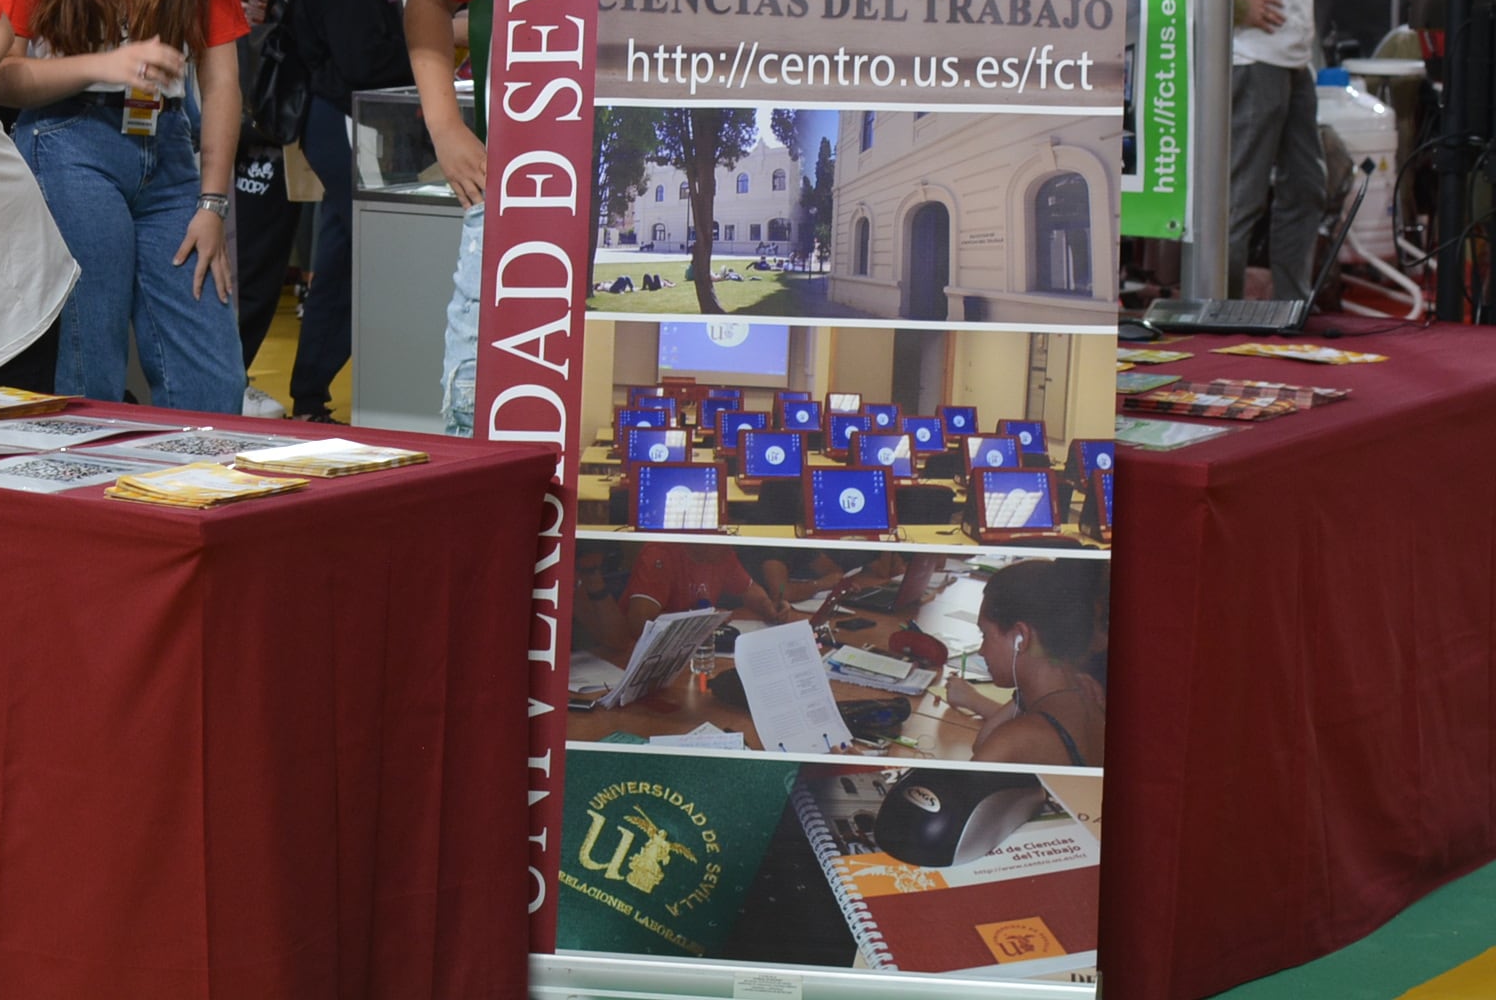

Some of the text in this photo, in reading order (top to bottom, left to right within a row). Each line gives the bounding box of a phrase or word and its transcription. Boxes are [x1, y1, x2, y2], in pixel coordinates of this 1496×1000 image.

[626, 38, 1094, 95] http://centro.us.es/fct
[589, 781, 721, 918] UNIVERSIDAD DE SEVILLA
[1012, 852, 1033, 862] del
[1034, 844, 1082, 858] Trabajo
[1023, 836, 1075, 850] Ciencias
[558, 869, 634, 916] RELACIONES
